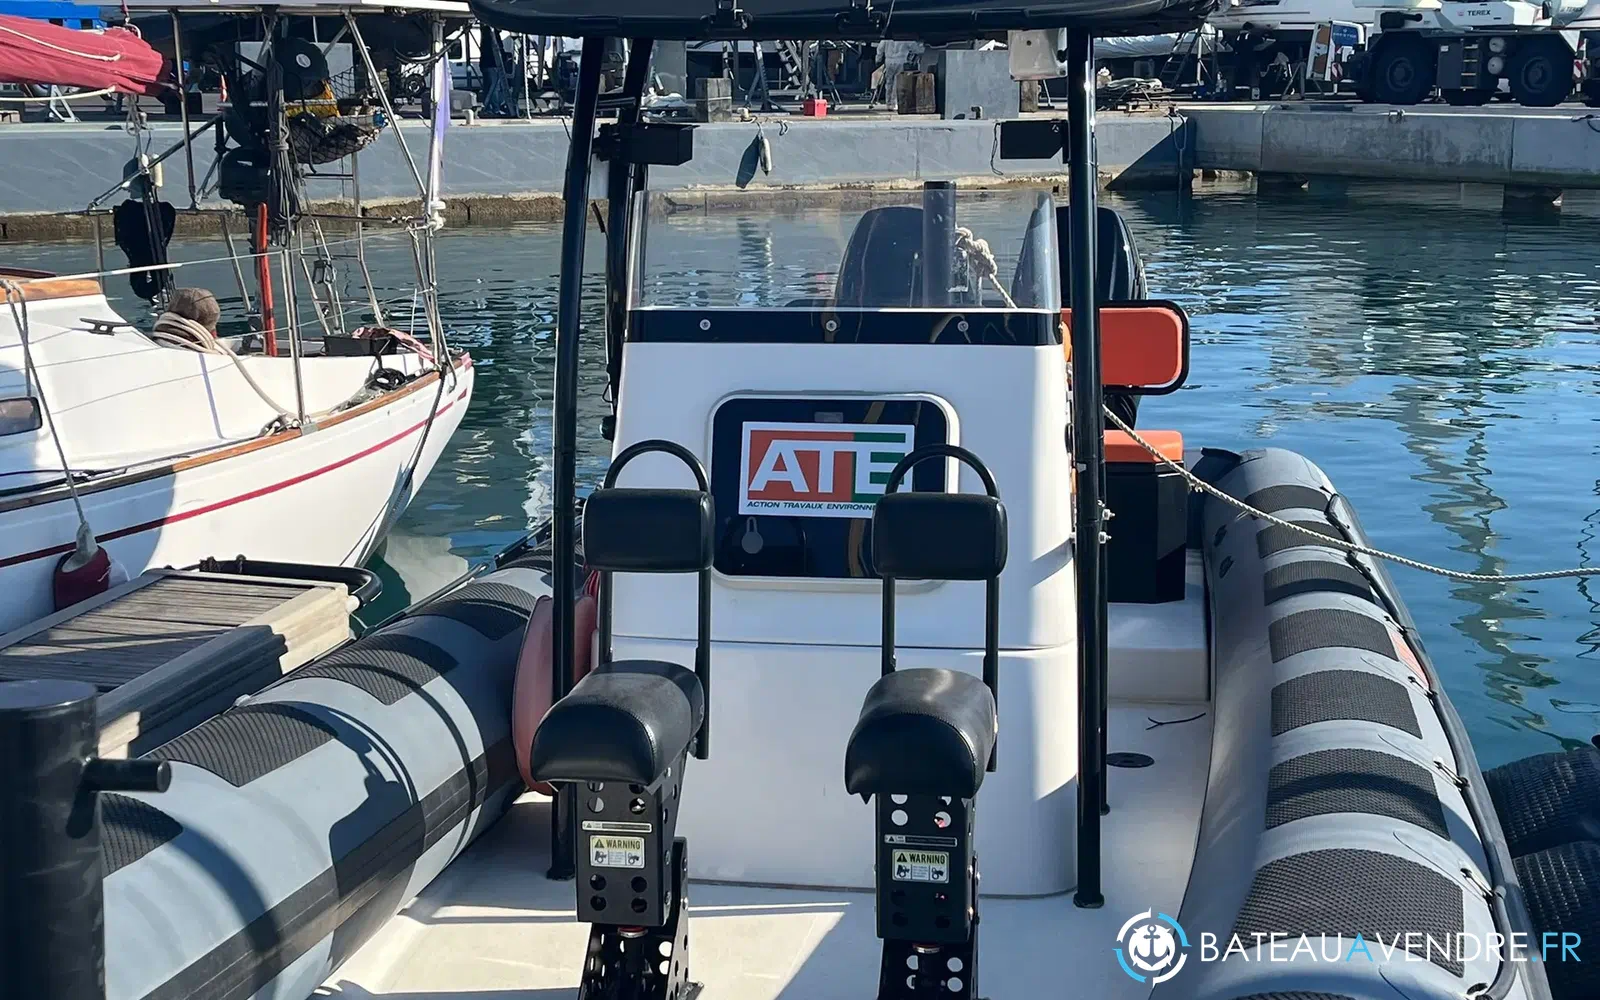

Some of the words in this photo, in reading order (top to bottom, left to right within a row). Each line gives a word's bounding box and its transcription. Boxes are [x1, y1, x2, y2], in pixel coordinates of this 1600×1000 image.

[748, 439, 906, 494] ATE
[606, 839, 641, 850] WARNING
[909, 853, 946, 865] WARNING
